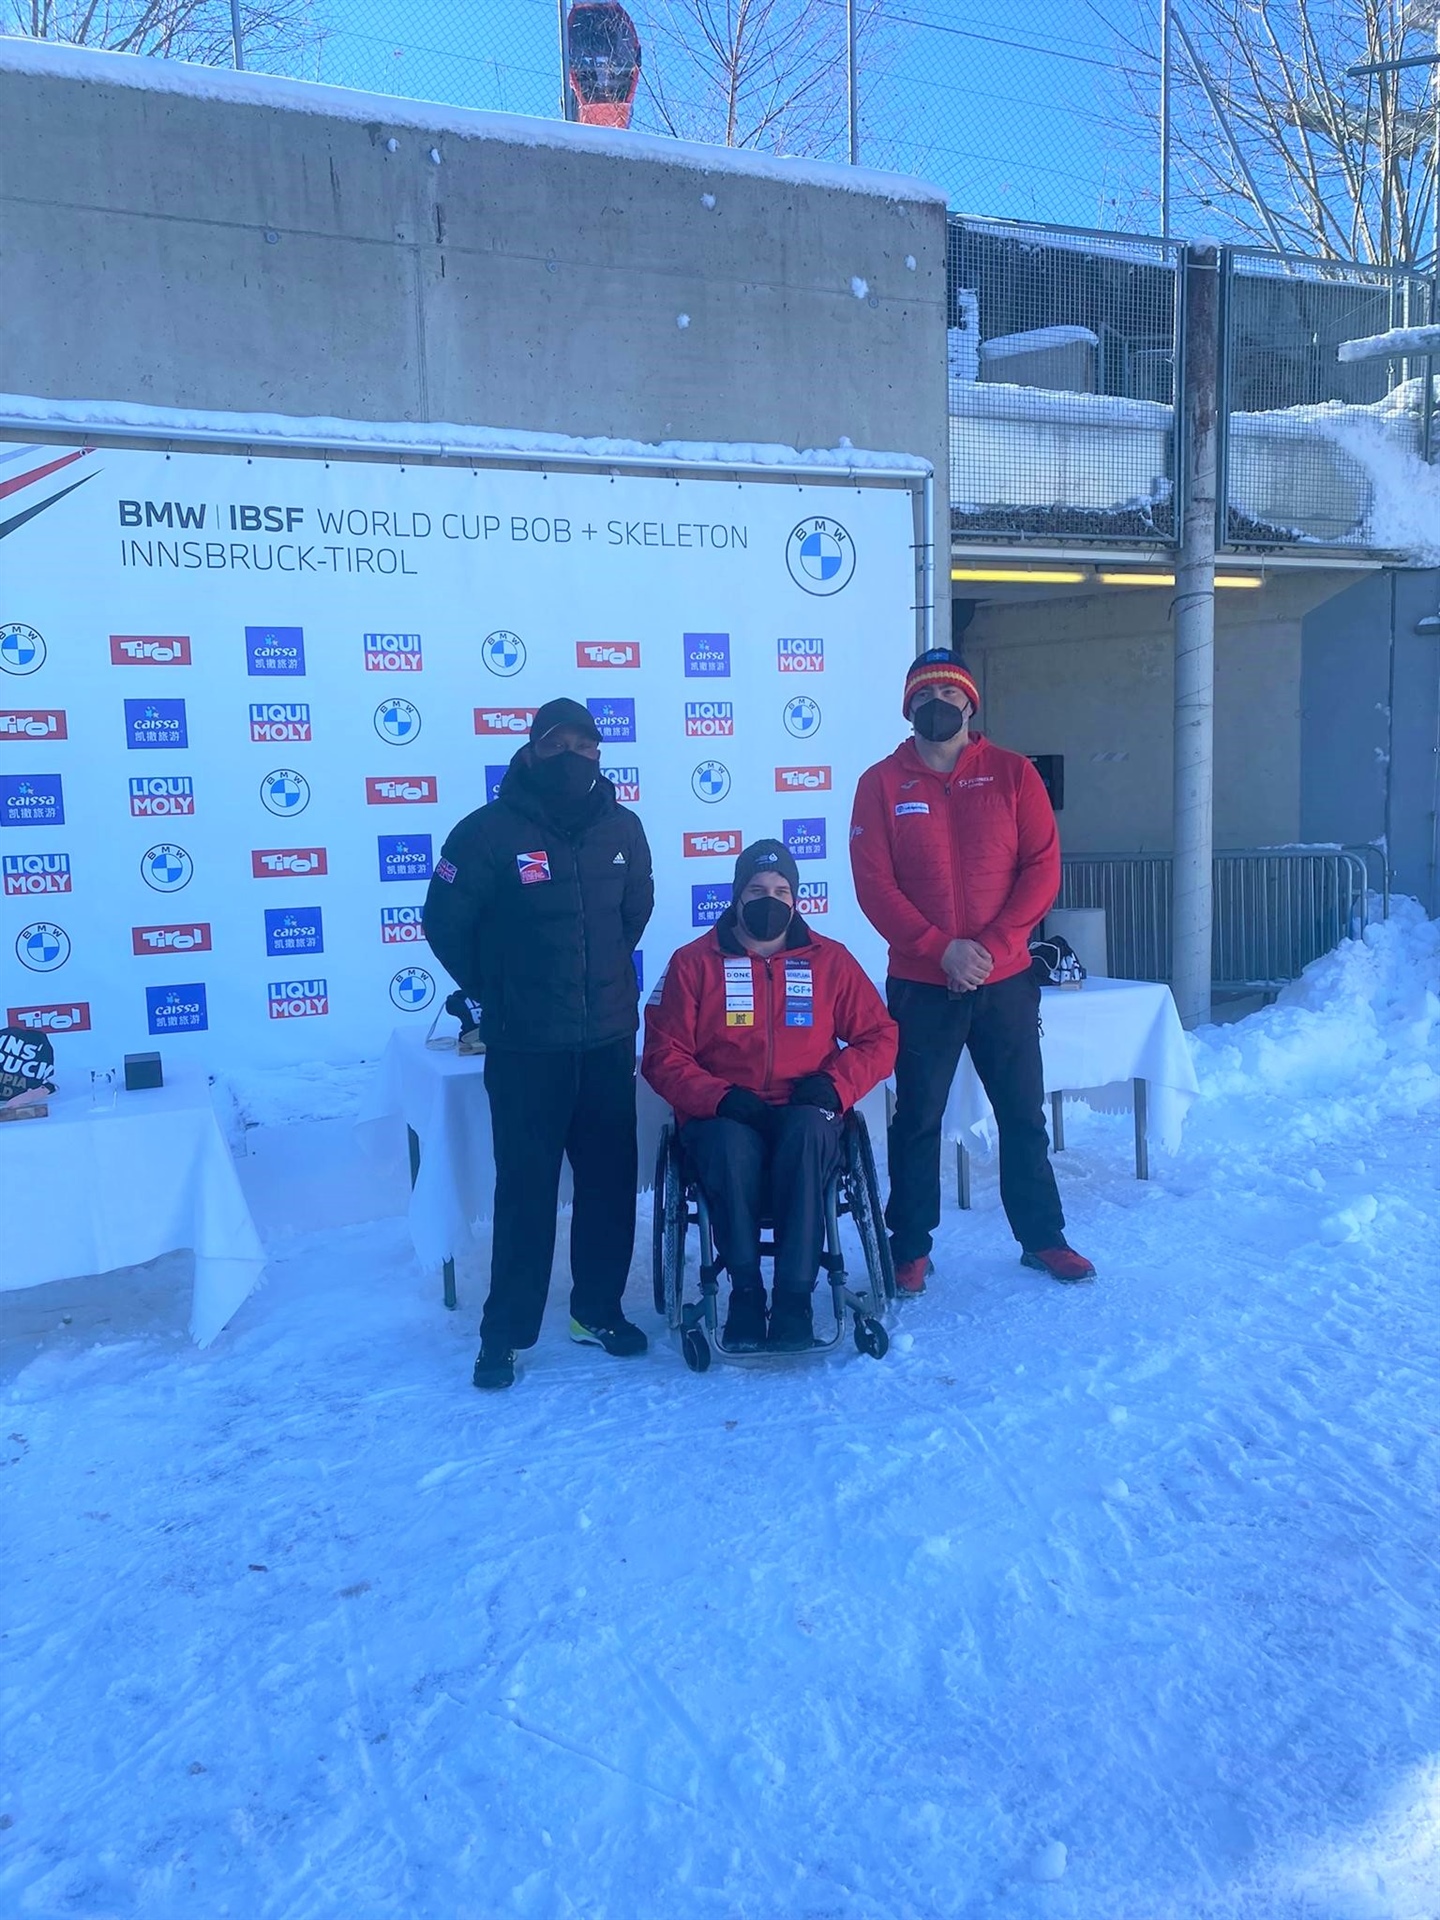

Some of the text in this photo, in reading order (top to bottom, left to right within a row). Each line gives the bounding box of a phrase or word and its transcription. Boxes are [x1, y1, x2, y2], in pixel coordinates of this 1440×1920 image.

[118, 500, 206, 530] BMW
[230, 503, 304, 533] IBSF
[317, 507, 431, 539] WORLD
[442, 513, 500, 541] CUP
[511, 515, 572, 543] BOB
[607, 520, 749, 549] SKELETON
[795, 520, 846, 542] BMW
[120, 540, 418, 574] INNSBRUCK-TIROL
[367, 635, 419, 653] LIQUI
[487, 633, 520, 646] BMW
[779, 639, 822, 654] LIQUI
[120, 641, 182, 662] Tirol
[254, 647, 297, 657] caissa
[584, 646, 632, 665] Tirol
[690, 651, 724, 660] caissa
[367, 653, 421, 670] MOLY
[779, 656, 822, 671] MOLY
[380, 700, 414, 714] BMW
[686, 703, 731, 719] LIQUI
[788, 698, 816, 711] BMW
[252, 705, 308, 723] LIQUI
[482, 713, 533, 731] Tirol
[594, 717, 630, 726] caissa
[134, 719, 179, 730] caissa
[253, 723, 310, 741] MOLY
[687, 719, 733, 735] MOLY
[600, 768, 637, 783] QUI
[697, 763, 726, 776] BMW
[266, 771, 302, 786] BMW
[781, 771, 825, 788] Tirol
[131, 778, 190, 796] LIQUI
[374, 781, 429, 800] Tirol
[7, 796, 55, 806] caissa
[133, 797, 193, 815] MOLY
[8, 808, 57, 819] 凯撒旅游
[690, 835, 736, 853] Tirol
[789, 835, 821, 844] caissa
[147, 846, 185, 860] BMW
[386, 853, 427, 863] caissa
[5, 855, 68, 875] LIQUI
[261, 853, 319, 873] Tirol
[7, 874, 70, 894] MOLY
[797, 883, 826, 898] QUI
[697, 901, 731, 910] caissa
[795, 898, 827, 914] OLY
[22, 925, 62, 940] BMW
[142, 928, 202, 949] Tirol
[273, 927, 315, 938] caissa
[384, 924, 426, 942] MOL
[395, 969, 429, 983] BMW
[271, 981, 325, 1000] LIQUI
[155, 1003, 199, 1015] caissa
[271, 999, 327, 1018] MOLY
[17, 1008, 81, 1029] Tirol
